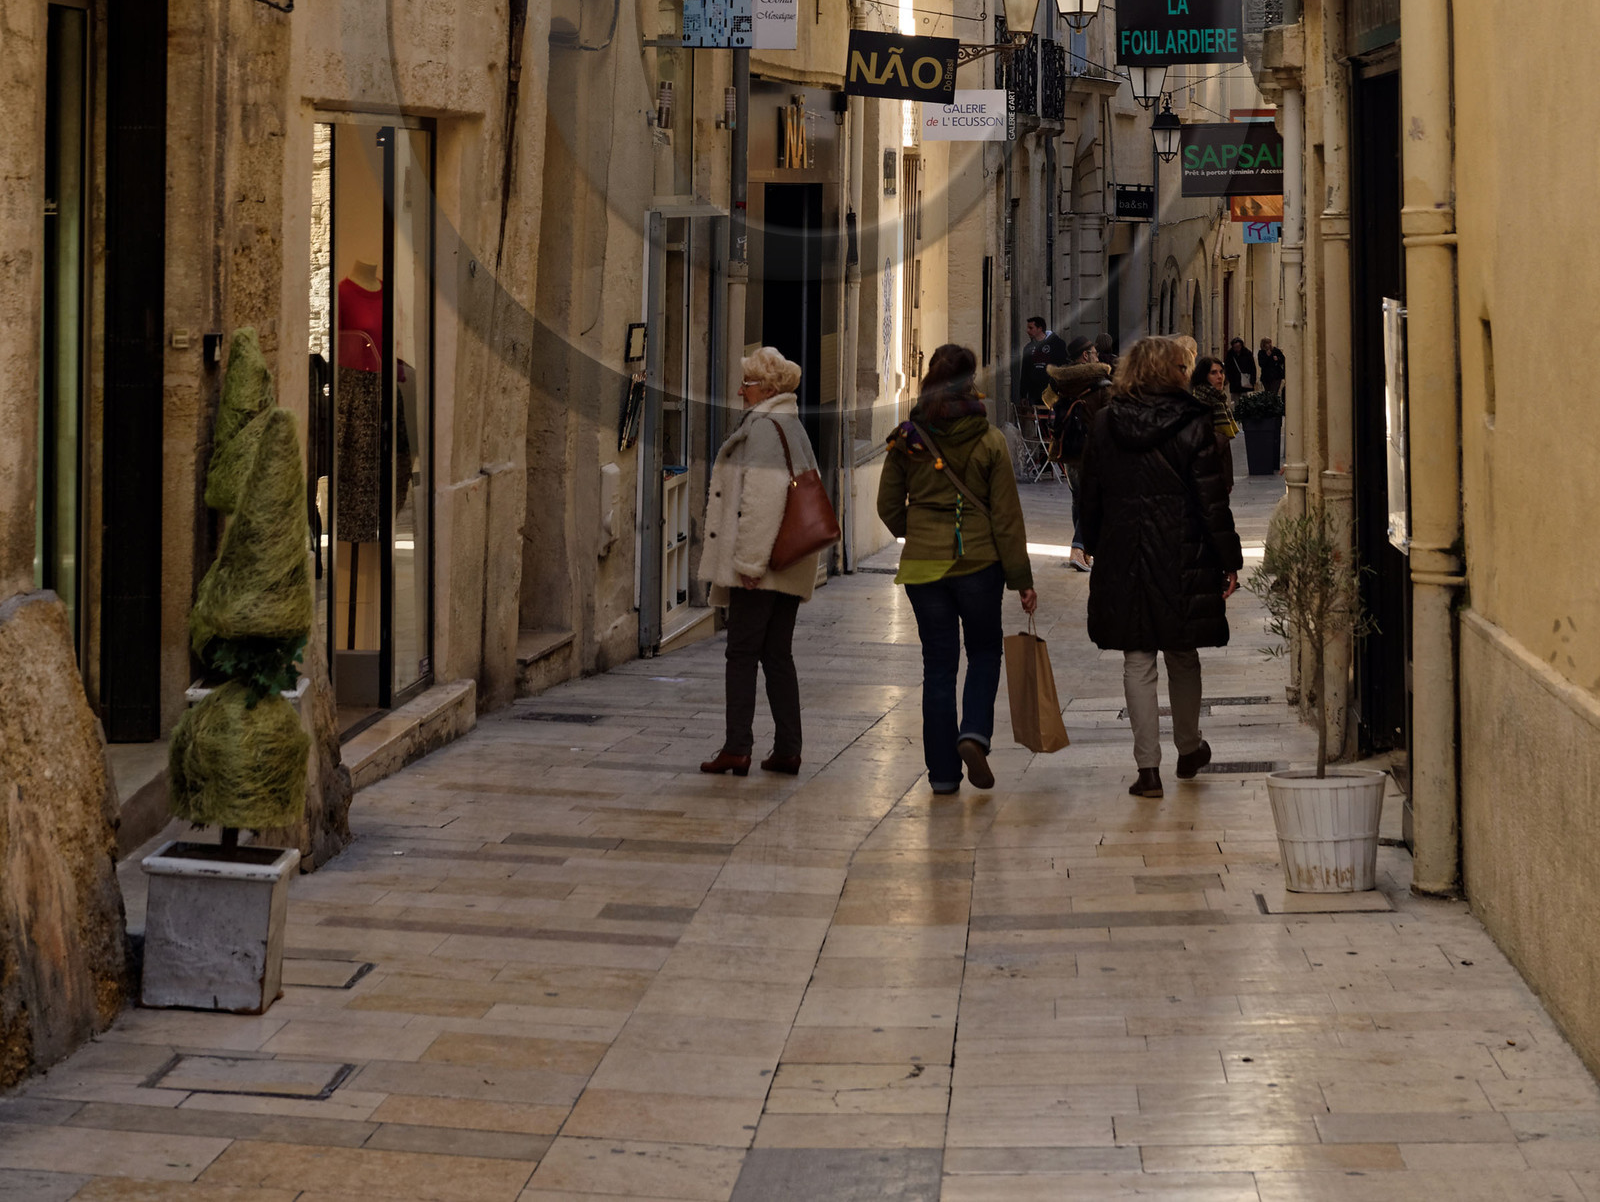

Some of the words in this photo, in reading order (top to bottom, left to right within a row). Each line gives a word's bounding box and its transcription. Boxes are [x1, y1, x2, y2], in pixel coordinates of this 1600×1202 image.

[1121, 28, 1238, 55] FOULARDIERE
[850, 46, 943, 90] NÃO
[944, 59, 954, 79] Brasil
[943, 79, 952, 92] Do
[943, 104, 987, 114] GALERIE
[926, 117, 939, 127] de
[1008, 112, 1016, 140] GALERIE
[1206, 169, 1228, 177] porter
[1119, 200, 1148, 209] ba&sh
